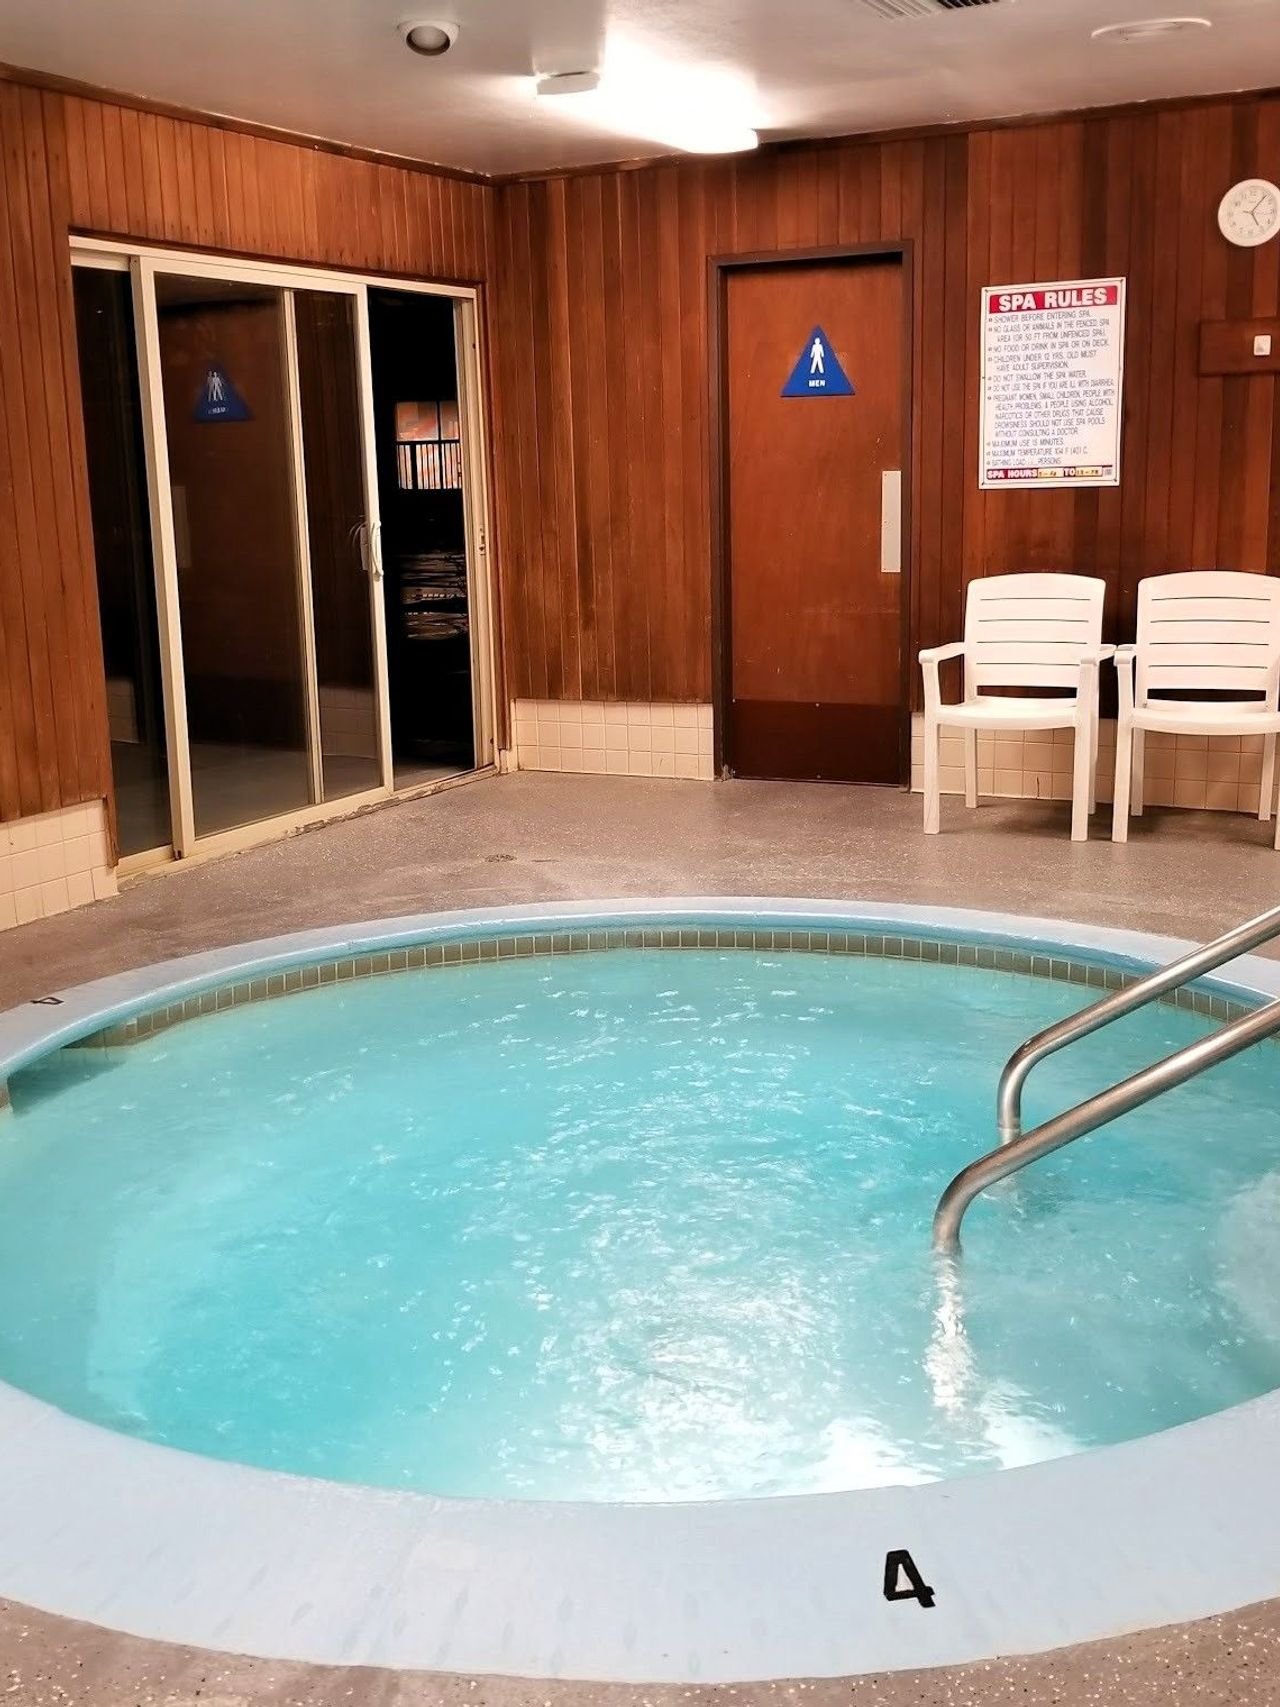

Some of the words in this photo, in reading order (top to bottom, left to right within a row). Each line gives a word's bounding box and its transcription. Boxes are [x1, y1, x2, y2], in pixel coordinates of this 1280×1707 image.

[999, 294, 1036, 312] SPA
[1044, 288, 1107, 308] RULES
[987, 470, 1005, 479] SPA
[1008, 469, 1038, 478] HOURS
[1063, 468, 1076, 476] TO
[883, 1549, 936, 1608] 4
